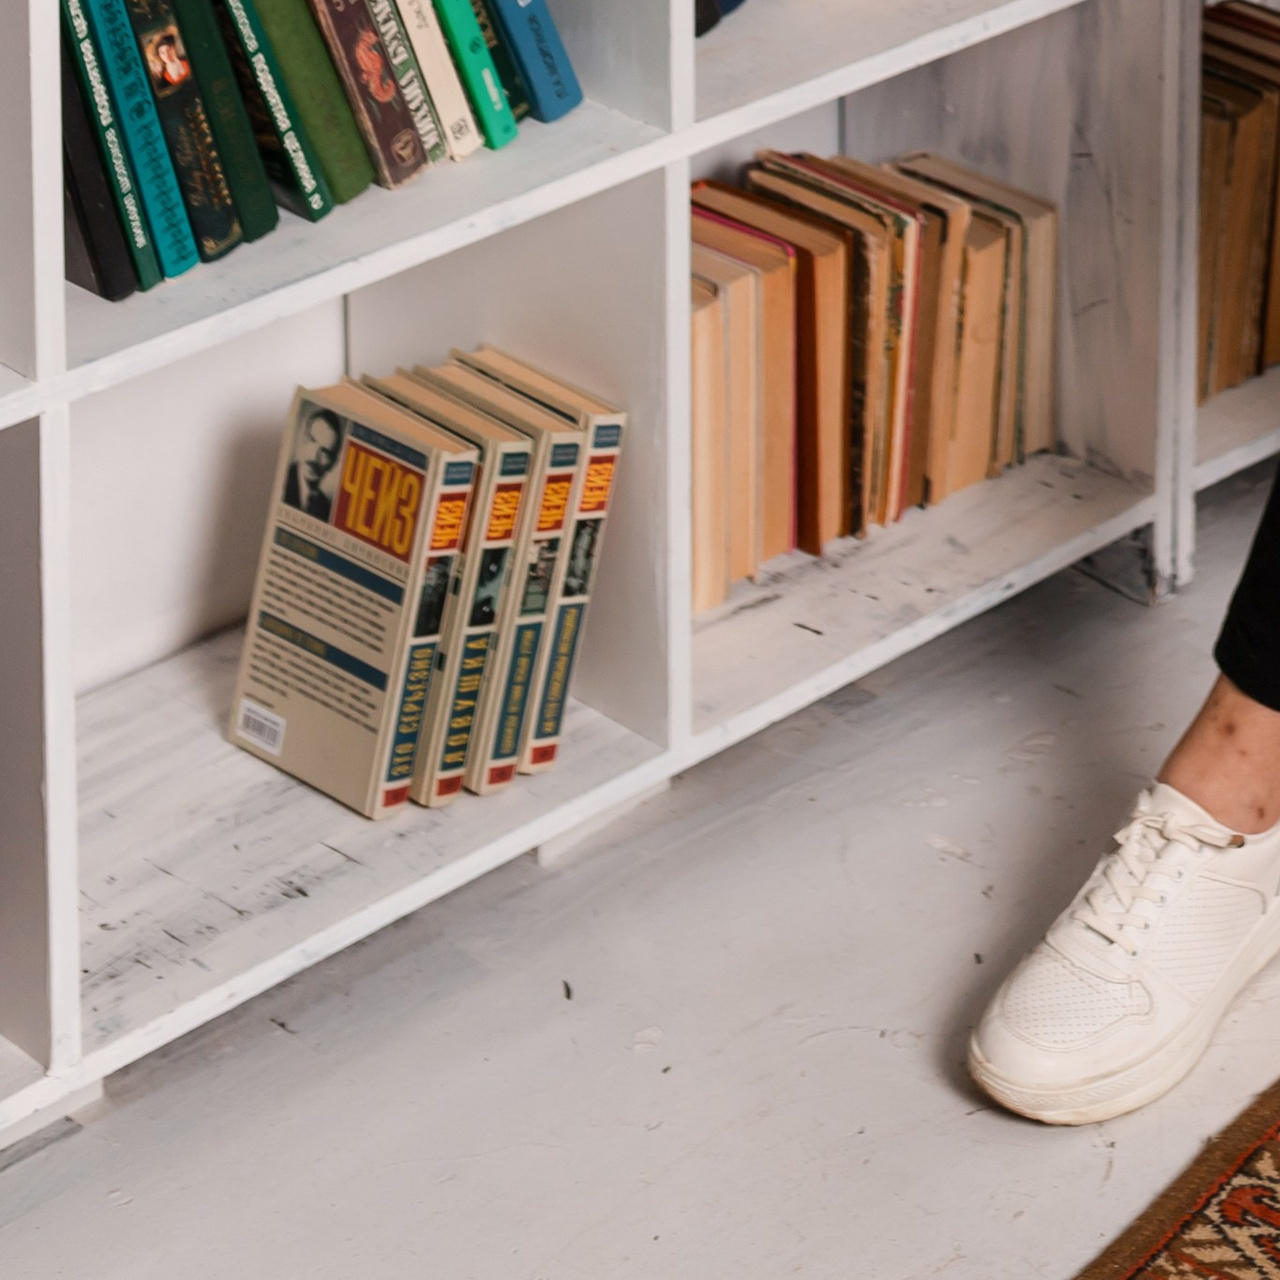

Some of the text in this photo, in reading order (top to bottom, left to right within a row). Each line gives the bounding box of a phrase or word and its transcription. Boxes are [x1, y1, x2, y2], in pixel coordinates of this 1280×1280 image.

[78, 39, 114, 125] ПОДНЯТАЯ
[249, 54, 292, 132] ПОДНЯТАЯ
[280, 130, 317, 193] ЦЕЛИНА
[396, 68, 440, 151] МИХАИЛ
[102, 126, 132, 194] ШОЛОХОВ
[121, 193, 147, 249] МИХАИЛ
[343, 444, 420, 556] ЧЕЙЗ
[390, 647, 432, 778] ЭТО СЕРЬЕЗНО
